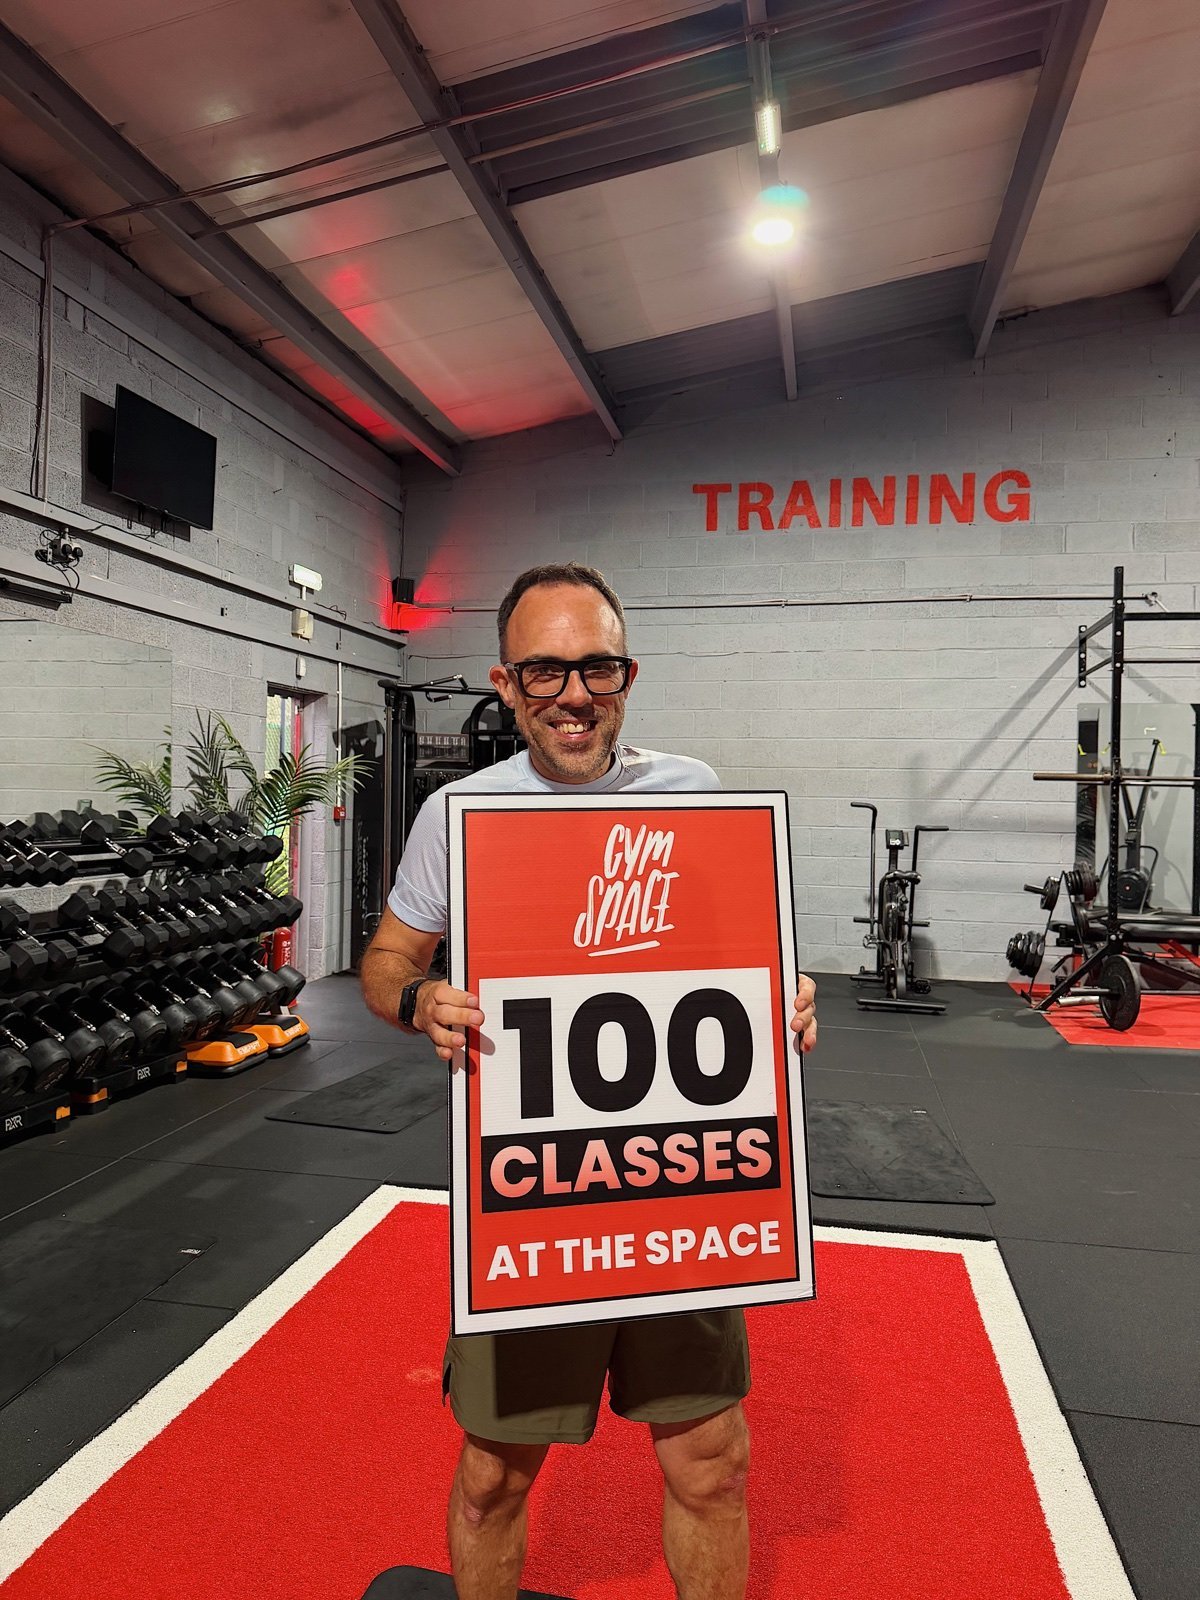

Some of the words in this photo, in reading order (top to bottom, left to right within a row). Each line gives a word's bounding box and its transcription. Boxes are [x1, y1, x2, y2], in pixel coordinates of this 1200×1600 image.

[693, 469, 1031, 531] TRAINING
[604, 823, 675, 879] GYM
[574, 870, 680, 948] SPACE
[503, 987, 754, 1120] 100
[489, 1128, 772, 1198] CLASSES
[487, 1241, 546, 1281] AT
[555, 1233, 636, 1274] THE
[645, 1220, 781, 1265] SPACE
